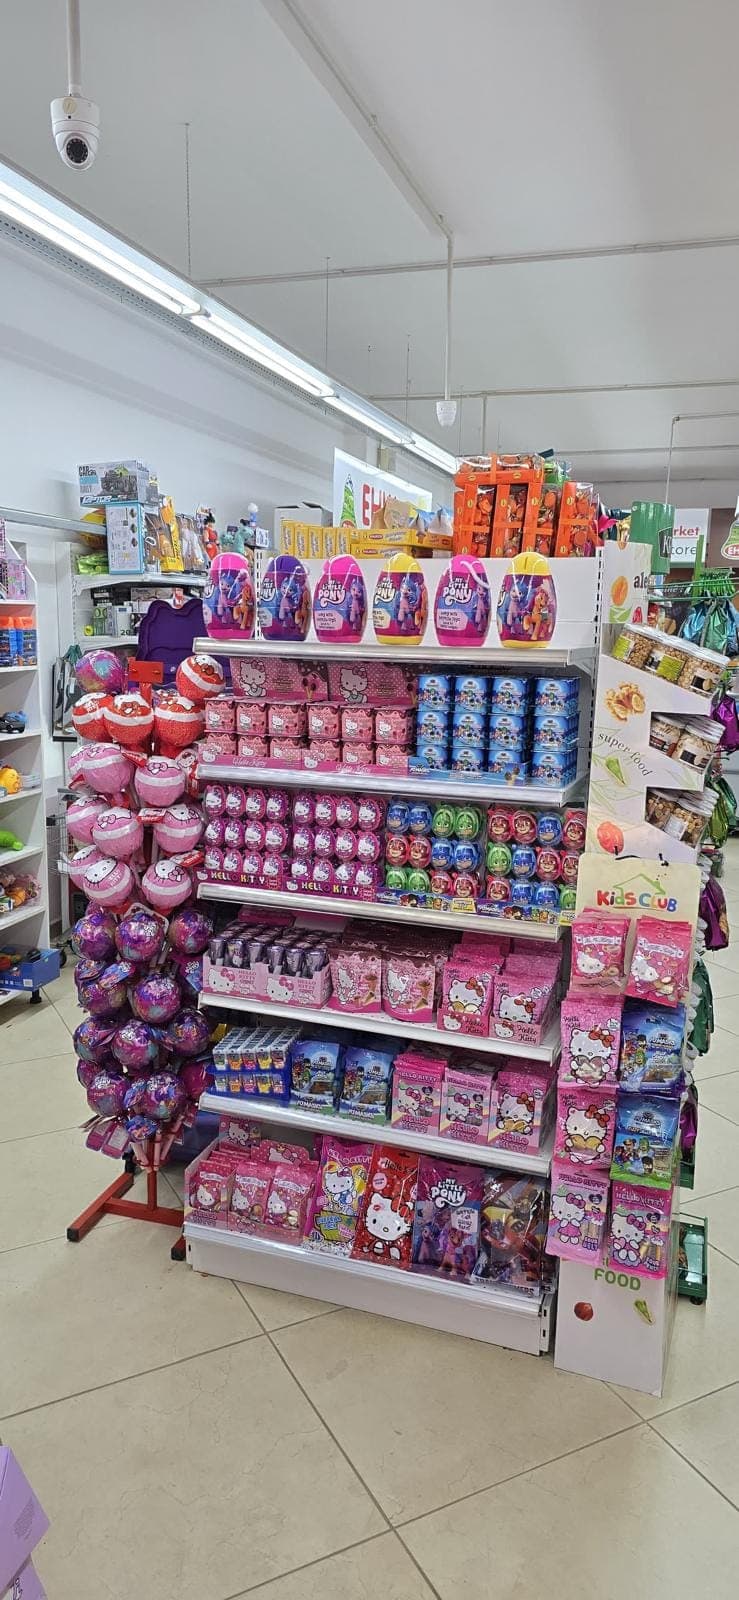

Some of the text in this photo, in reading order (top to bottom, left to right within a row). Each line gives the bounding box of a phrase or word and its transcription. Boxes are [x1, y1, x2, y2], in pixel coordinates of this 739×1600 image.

[599, 733, 631, 753] super
[630, 751, 653, 777] food
[211, 870, 238, 881] HELLO
[302, 881, 330, 892] HELLO
[518, 1024, 537, 1035] Hello
[519, 1034, 537, 1044] Kitty
[438, 1181, 463, 1192] LITTLE
[430, 1186, 467, 1208] PONY
[594, 1267, 641, 1291] FOOD
